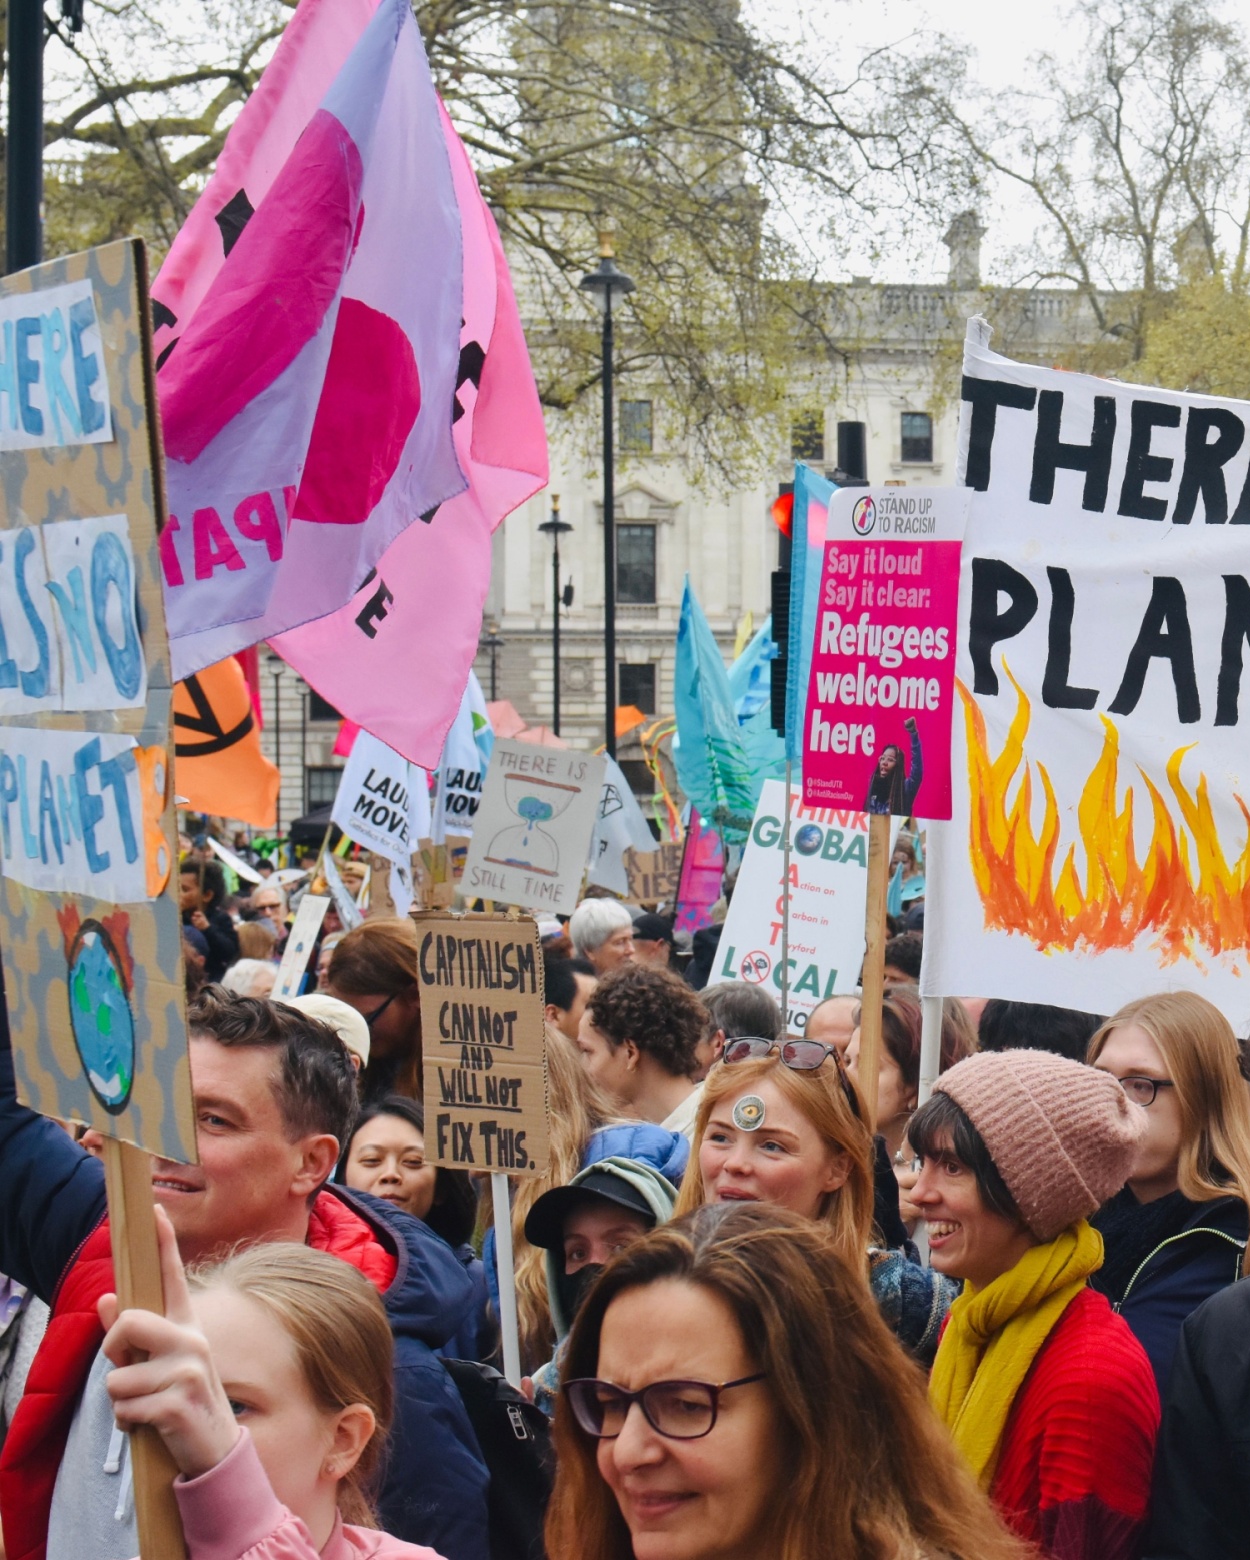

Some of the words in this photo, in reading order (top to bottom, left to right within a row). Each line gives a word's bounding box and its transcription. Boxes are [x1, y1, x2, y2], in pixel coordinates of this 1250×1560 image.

[879, 497, 915, 515] STAND
[918, 498, 932, 514] UP
[879, 517, 891, 533] TO
[894, 517, 936, 533] RACISM
[827, 547, 859, 580] Say
[863, 547, 876, 573] it
[879, 548, 922, 575] loud
[825, 579, 857, 611] Say
[861, 579, 874, 606] it
[877, 580, 931, 608] clear:
[44, 531, 142, 700] NO
[819, 611, 949, 668] Refugees
[816, 662, 940, 711] welcome
[809, 709, 875, 756] here
[498, 751, 558, 774] THERE
[567, 761, 588, 780] IS
[0, 736, 137, 873] PLANET
[132, 745, 171, 898] B
[753, 815, 867, 868] GLOBA
[470, 866, 506, 890] STILL
[524, 877, 565, 902] TIME
[823, 888, 835, 896] on
[820, 916, 829, 925] in
[420, 931, 536, 994] CAPITALISM
[460, 1045, 493, 1070] AND
[438, 1067, 482, 1103] WILL
[486, 1075, 522, 1107] NOT
[436, 1114, 474, 1163] FIX
[480, 1121, 535, 1170] THIS.
